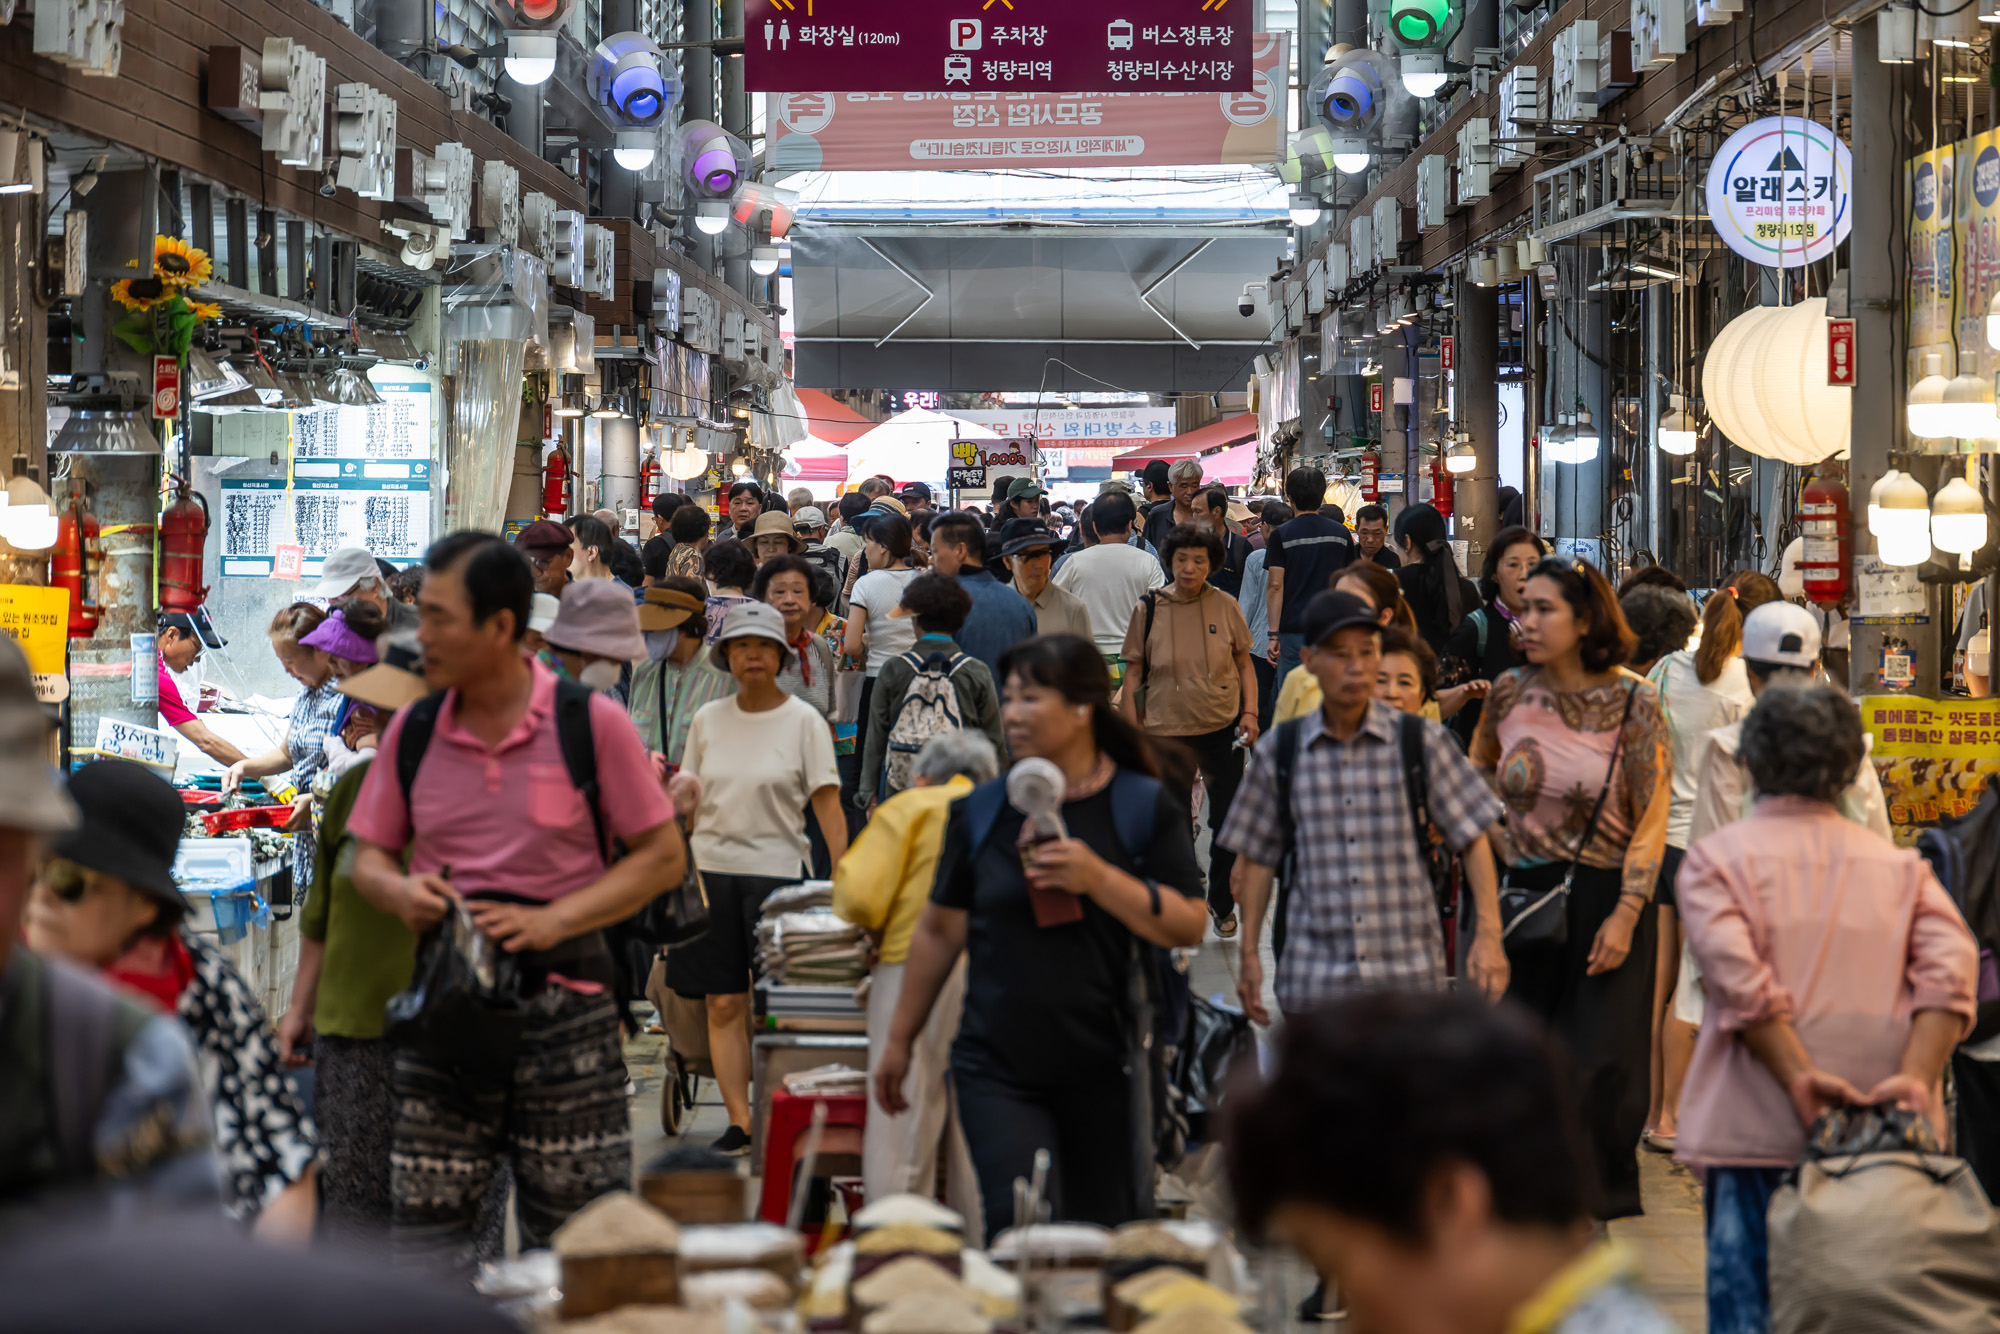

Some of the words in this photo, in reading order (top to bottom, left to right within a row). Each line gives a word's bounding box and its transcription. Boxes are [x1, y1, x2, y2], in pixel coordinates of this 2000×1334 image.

[799, 25, 855, 46] 화장실
[858, 32, 900, 45] (120m)
[991, 25, 1047, 46] 주차장
[1142, 25, 1234, 46] 버스정류장
[982, 60, 1052, 81] 청량리역
[1107, 60, 1234, 81] 청량리수산시장
[1733, 176, 1838, 203] 알래스카
[1746, 206, 1782, 216] 프리미엄
[1788, 205, 1826, 216] 퓨전카페
[1757, 223, 1787, 237] 청량리
[1790, 223, 1814, 237] 1호점
[952, 441, 978, 467] 빵
[978, 450, 1026, 468] 1,000원
[3, 612, 20, 624] 있는
[23, 613, 58, 626] 원조맛집
[22, 627, 30, 638] 집
[102, 738, 121, 754] 25
